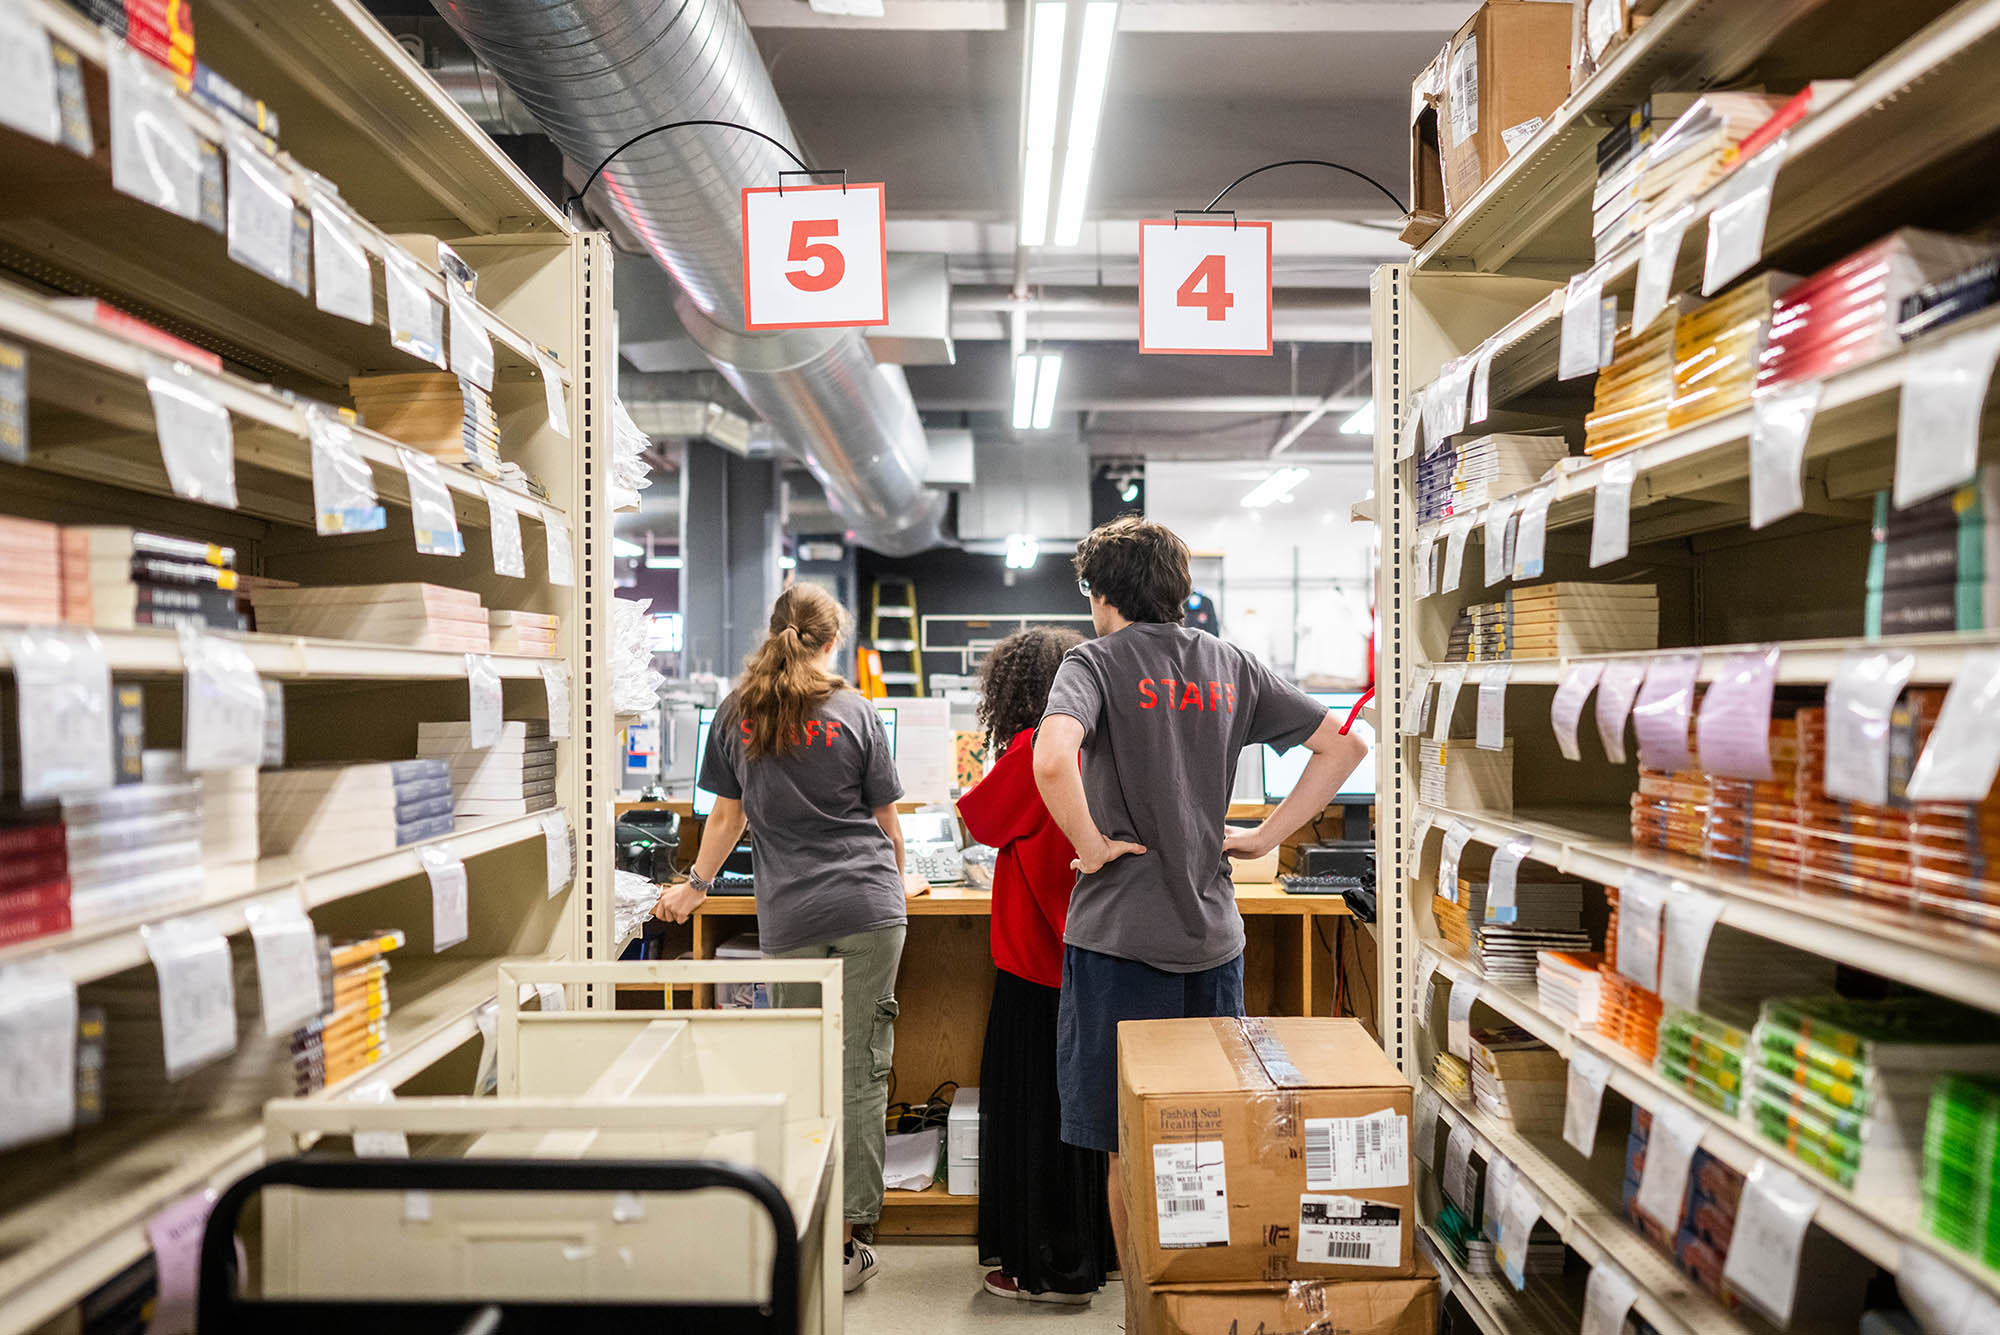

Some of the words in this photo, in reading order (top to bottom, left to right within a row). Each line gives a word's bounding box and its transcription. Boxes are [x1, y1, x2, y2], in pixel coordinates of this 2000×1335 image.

[784, 219, 846, 292] 5
[1176, 255, 1234, 321] 4
[1138, 678, 1236, 713] STAFF
[1160, 1107, 1198, 1119] Fashion
[1200, 1107, 1222, 1118] Seal
[1160, 1118, 1222, 1129] Healthcare
[1328, 1231, 1361, 1241] ATS258
